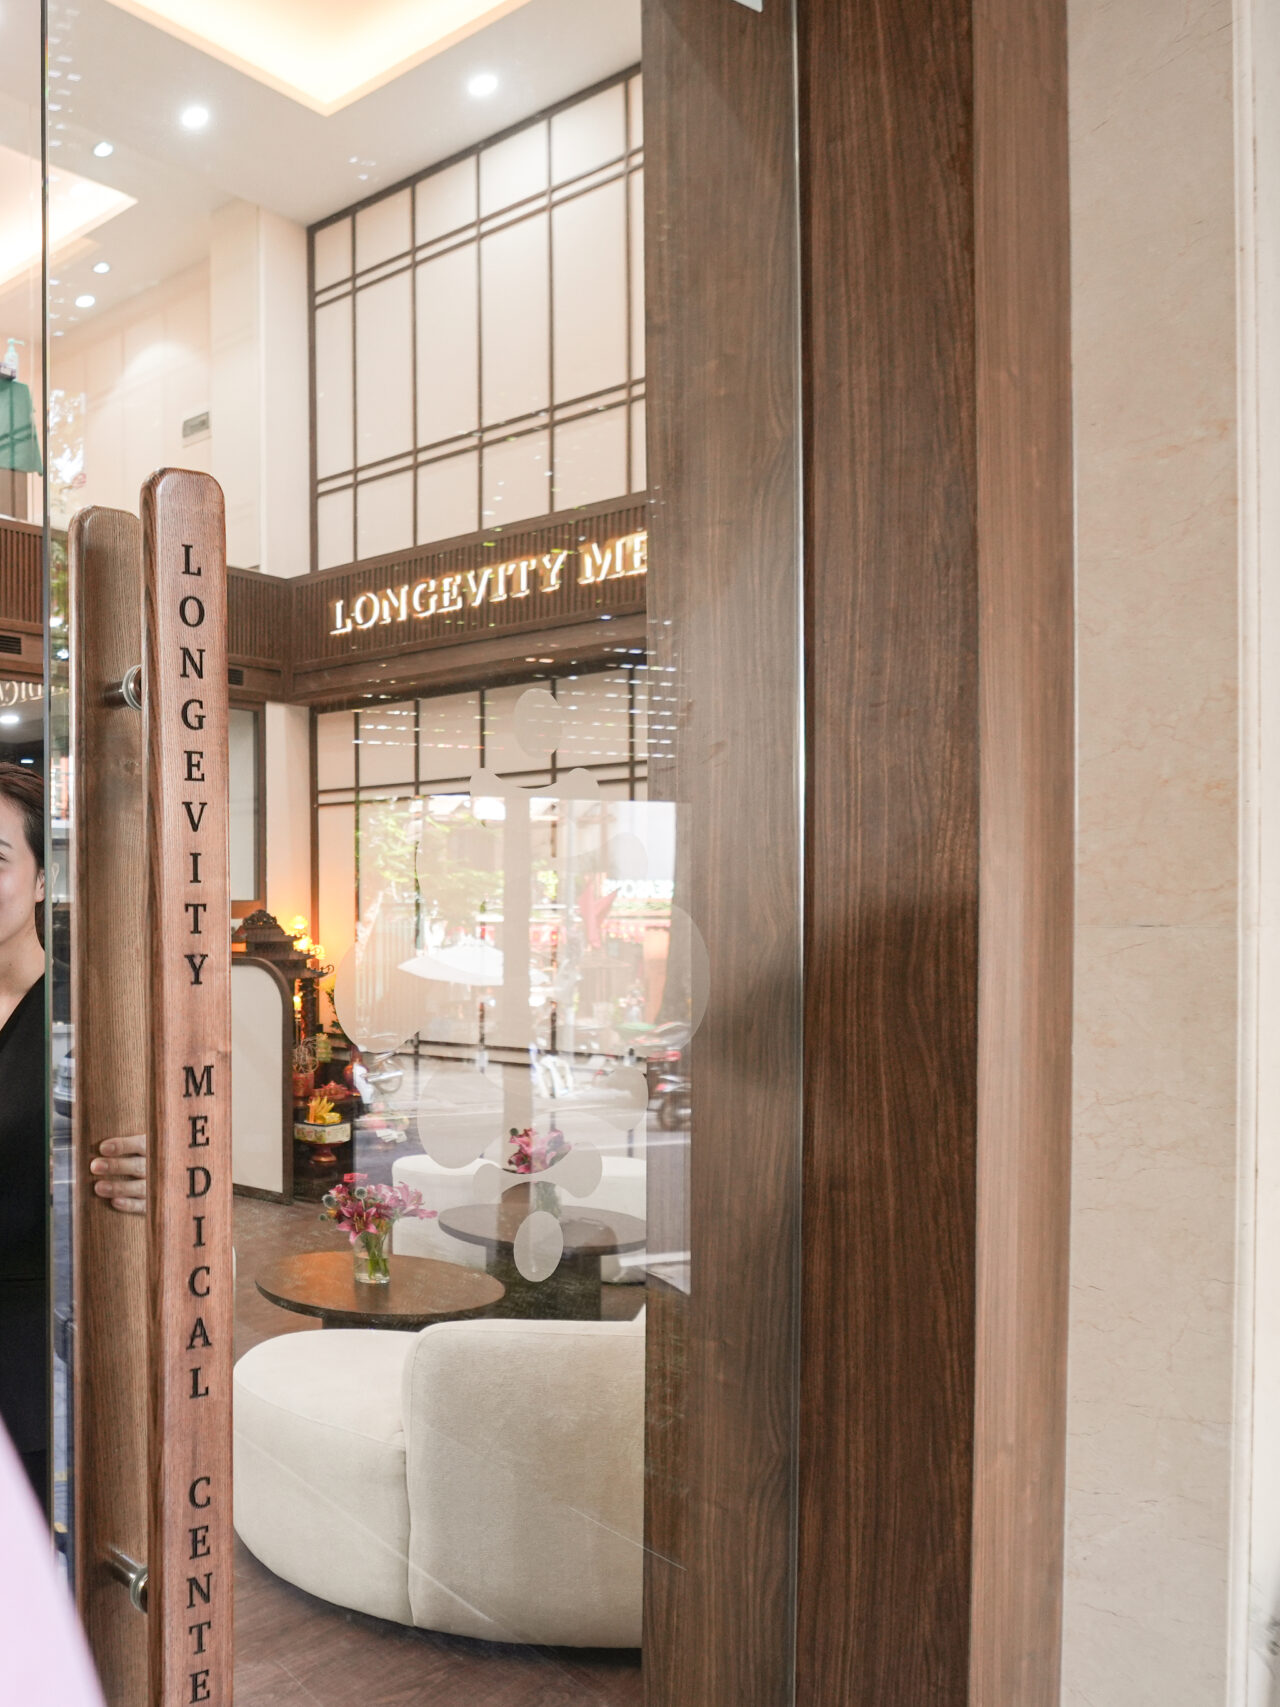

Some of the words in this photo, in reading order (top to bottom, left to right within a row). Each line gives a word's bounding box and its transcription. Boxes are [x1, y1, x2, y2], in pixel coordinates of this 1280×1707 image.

[329, 549, 568, 635] LONGEVITY
[180, 544, 208, 985] LONGEVITY
[183, 1065, 214, 1398] MEDICAL
[187, 1477, 212, 1704] CENTE
